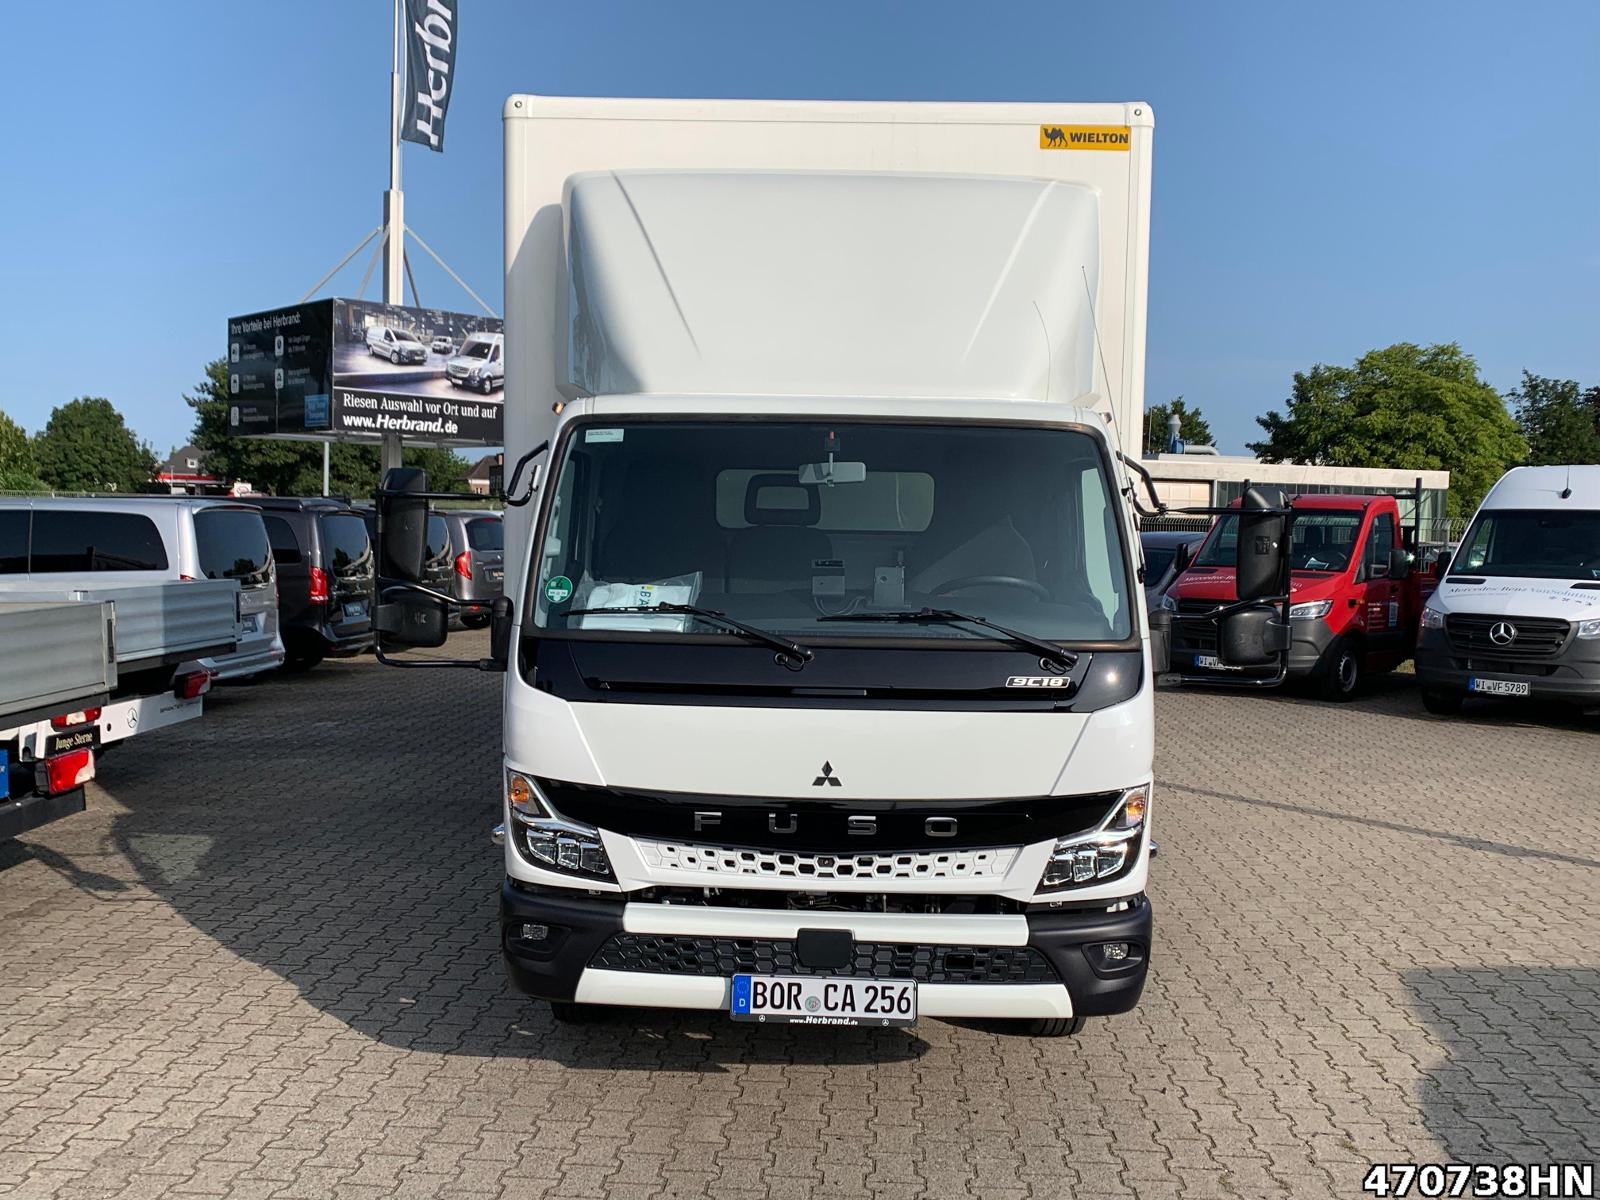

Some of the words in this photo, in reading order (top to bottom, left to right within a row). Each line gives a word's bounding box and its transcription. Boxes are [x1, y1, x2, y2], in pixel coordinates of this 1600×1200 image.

[1070, 132, 1129, 144] WIELTON
[231, 322, 242, 335] Ihre
[242, 318, 263, 333] Vorteile
[263, 316, 272, 330] bei
[343, 393, 377, 410] Riesen
[381, 397, 423, 413] Auswahl
[425, 403, 442, 415] vor
[443, 402, 459, 416] Ort
[461, 405, 480, 418] und
[481, 406, 498, 419] auf
[343, 413, 458, 434] www.Herbrand.de
[1492, 681, 1503, 692] VF
[1504, 683, 1527, 694] 5789
[56, 737, 74, 750] Junge
[74, 733, 93, 746] Sterne
[694, 811, 958, 837] FUSO
[738, 998, 746, 1008] D
[752, 981, 802, 1011] BOR
[824, 984, 857, 1013] CA
[864, 986, 912, 1015] 256
[790, 1016, 858, 1026] www.Herbrand.de
